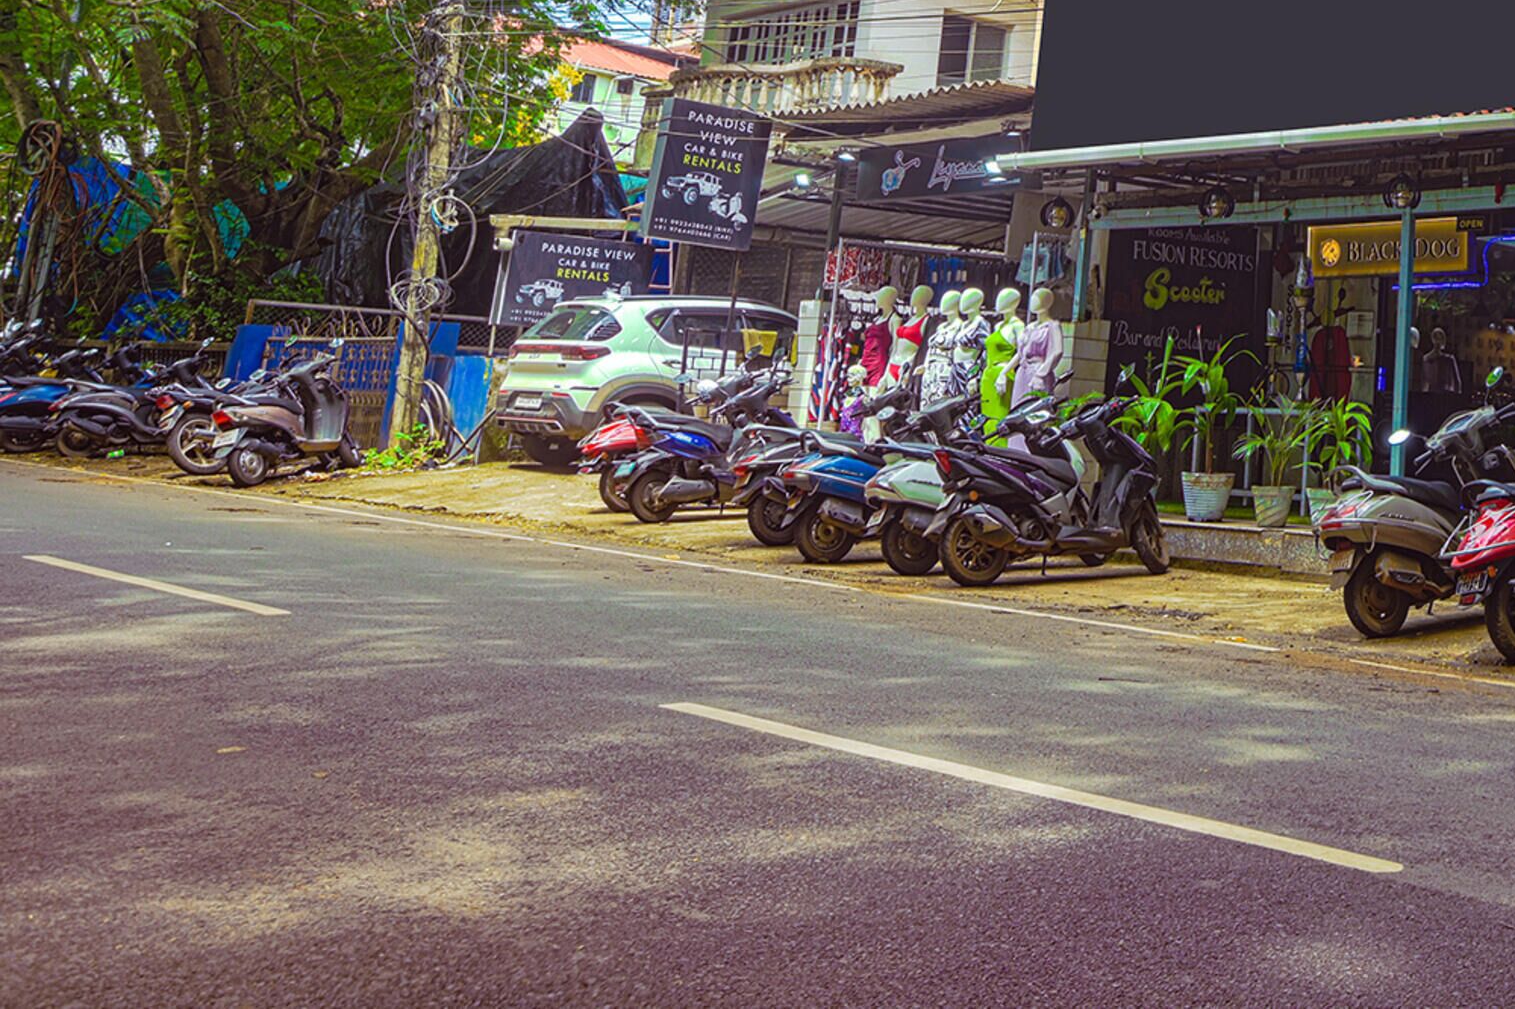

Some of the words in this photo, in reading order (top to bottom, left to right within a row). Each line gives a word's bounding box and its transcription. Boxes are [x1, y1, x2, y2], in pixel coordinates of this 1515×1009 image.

[687, 110, 755, 134] PARADISE
[700, 130, 737, 146] VIEW
[684, 143, 705, 155] CAR
[709, 149, 717, 157] &
[721, 150, 744, 162] BIKE
[682, 153, 743, 175] RENTALS
[1459, 219, 1484, 229] OPEN
[541, 242, 600, 258] PARADISE
[604, 249, 636, 261] VIEW
[1133, 240, 1186, 265] FUSION
[1190, 247, 1254, 272] RESORTS
[1413, 237, 1461, 259] DOG
[558, 258, 577, 267] CAR
[591, 261, 610, 271] BIKE
[556, 268, 610, 283] RENTALS
[1115, 320, 1142, 346] Bar
[1143, 326, 1165, 348] and
